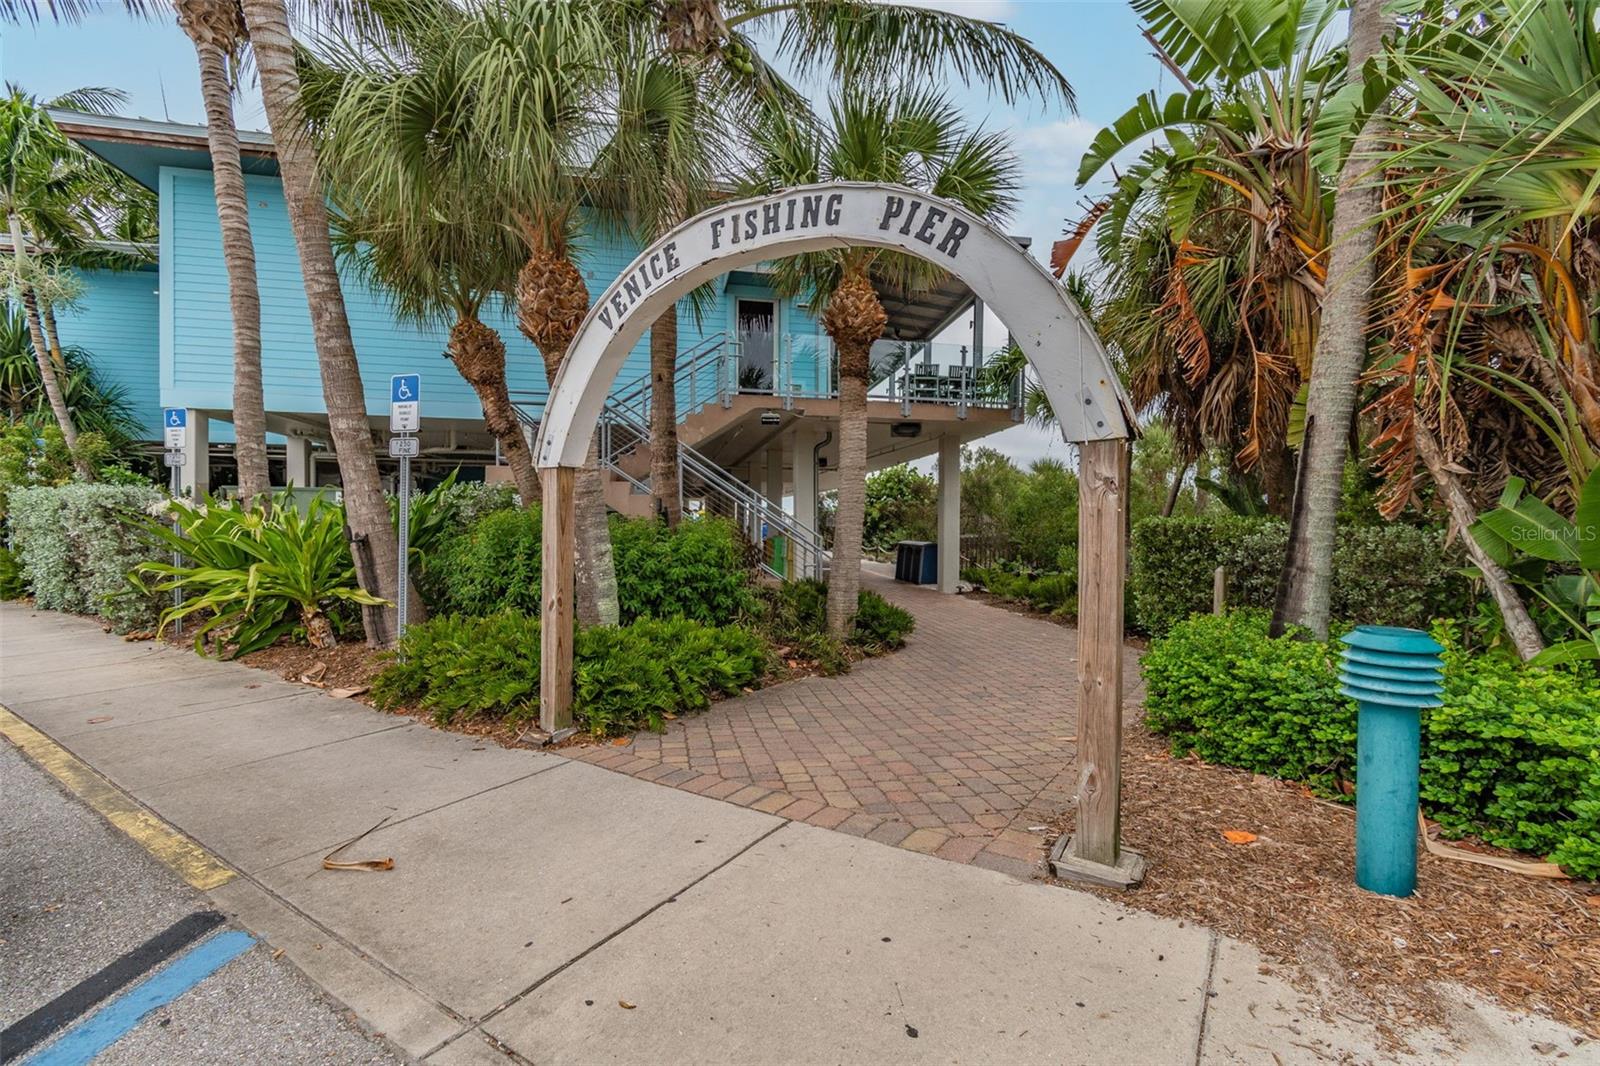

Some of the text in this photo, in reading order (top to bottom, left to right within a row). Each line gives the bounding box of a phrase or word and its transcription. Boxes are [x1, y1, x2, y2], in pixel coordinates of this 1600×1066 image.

[598, 194, 970, 331] VENICE FISHING PIER
